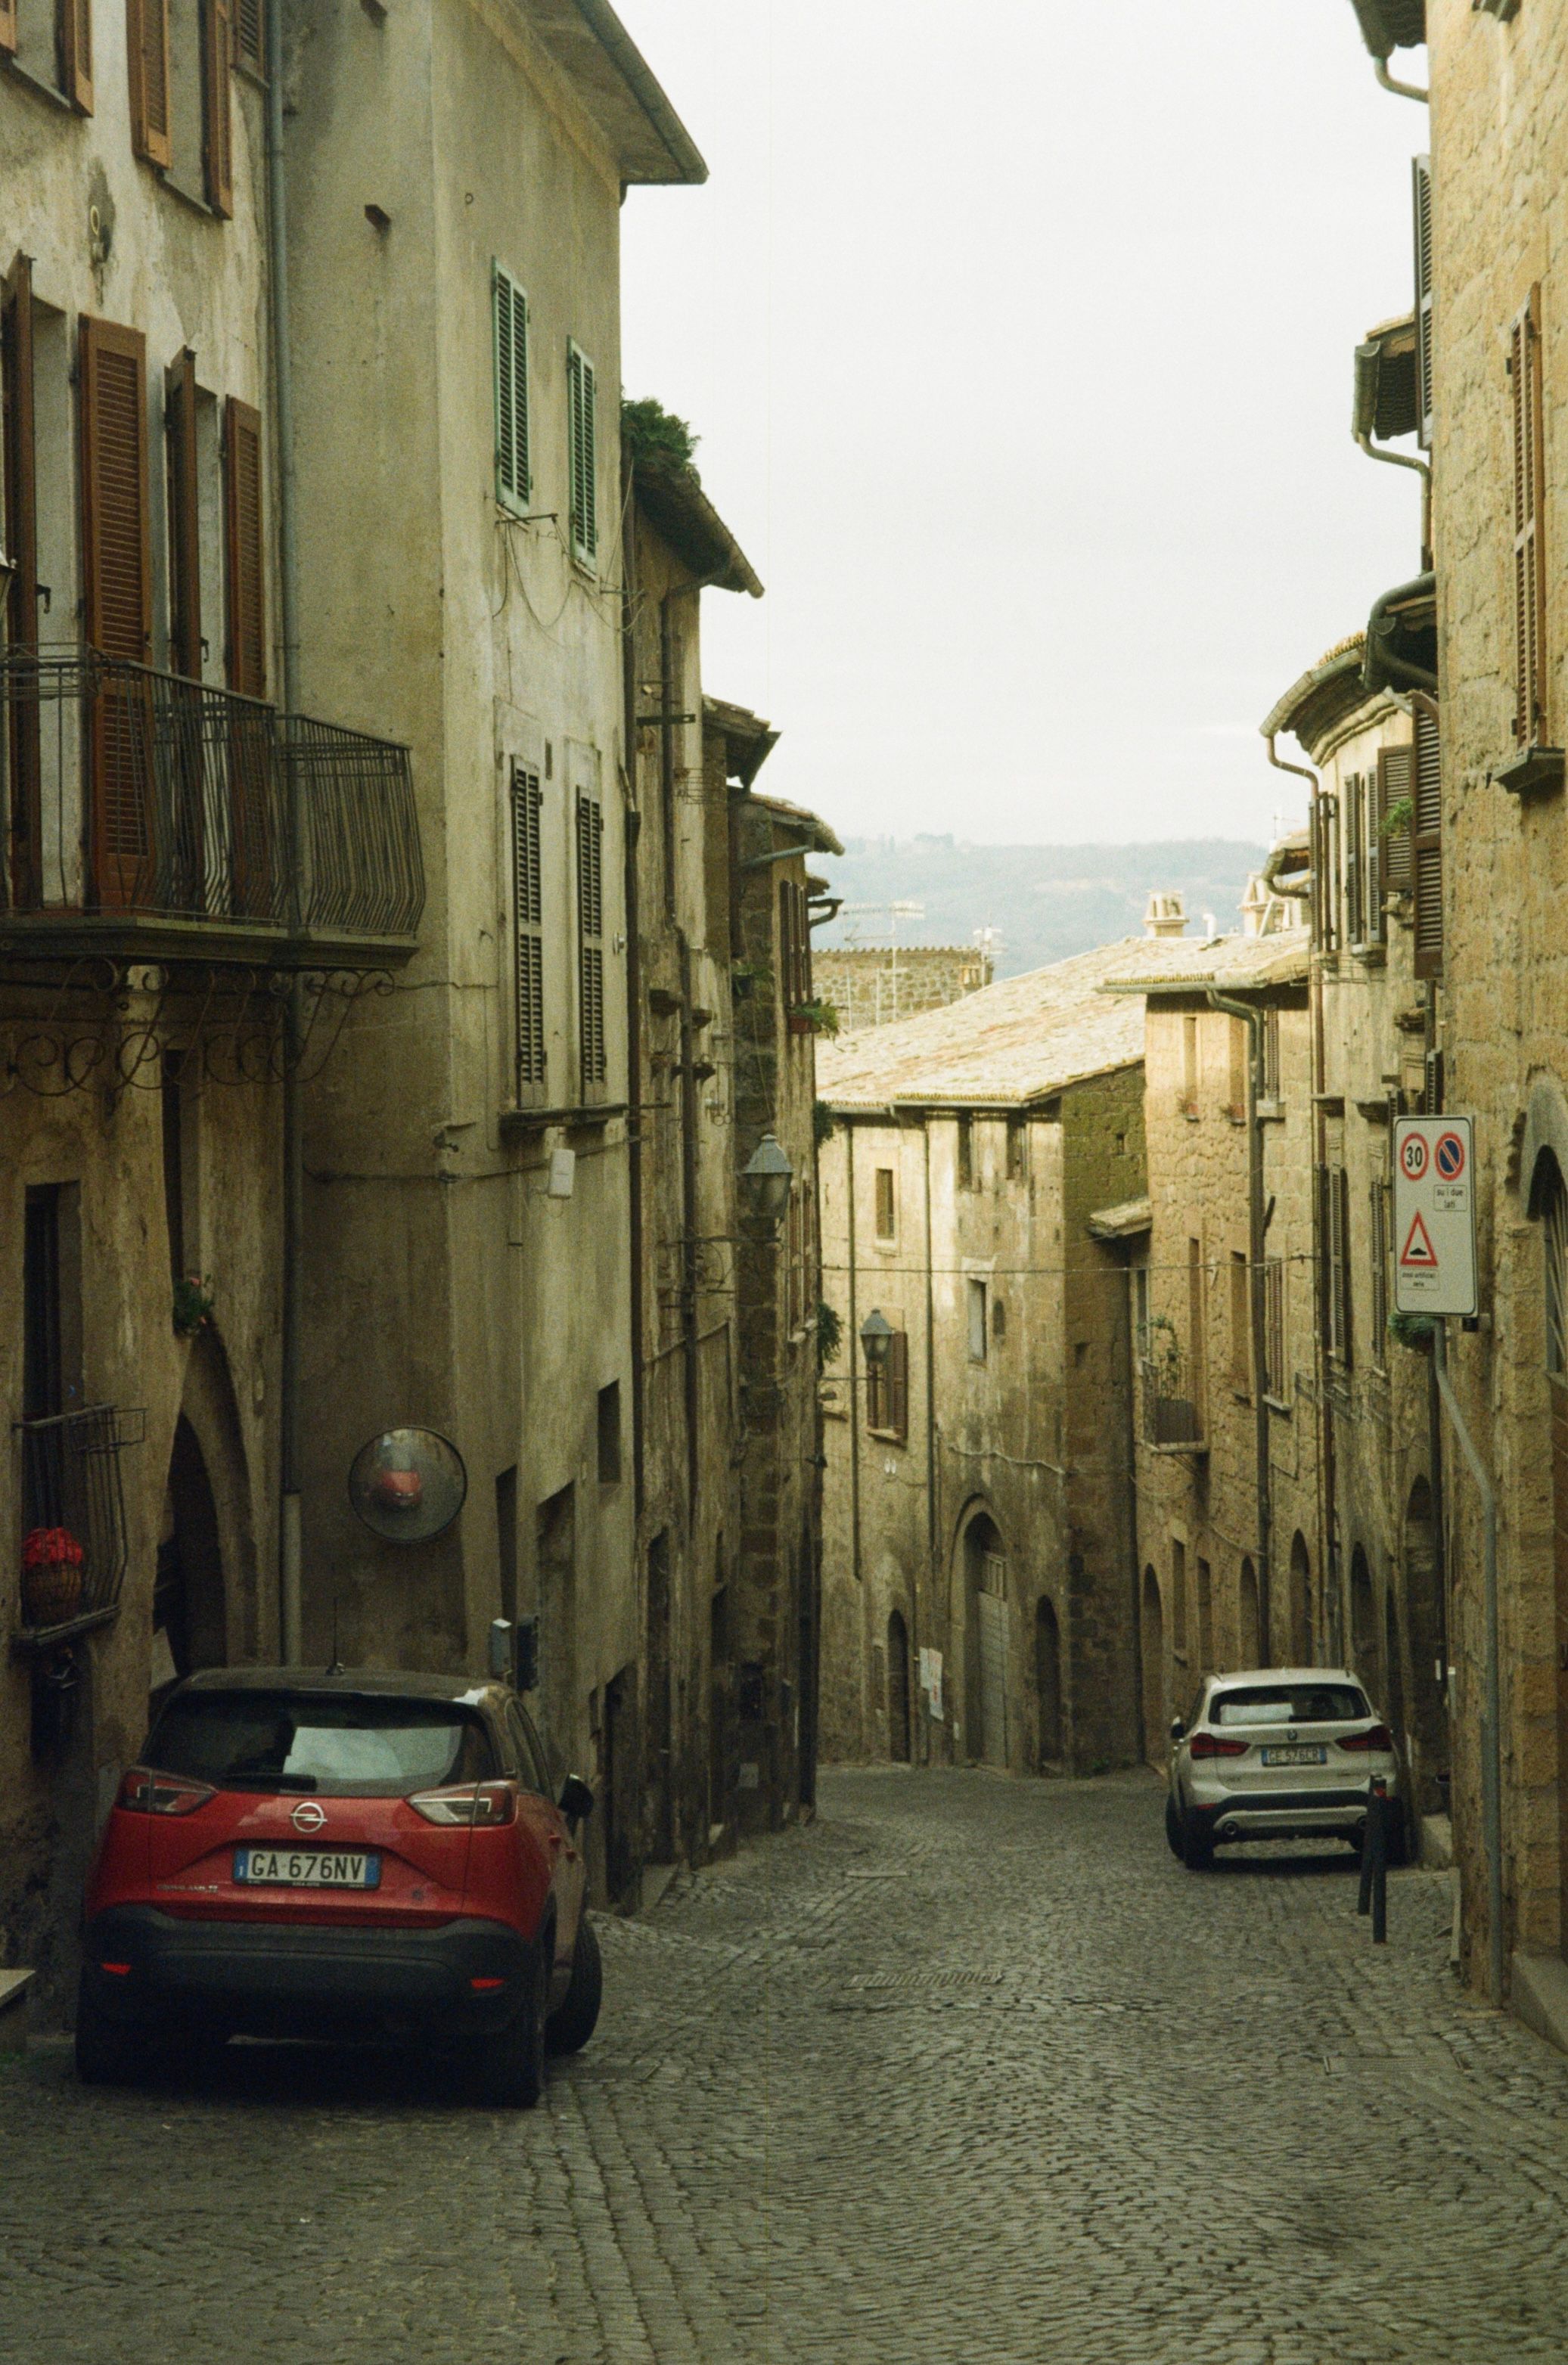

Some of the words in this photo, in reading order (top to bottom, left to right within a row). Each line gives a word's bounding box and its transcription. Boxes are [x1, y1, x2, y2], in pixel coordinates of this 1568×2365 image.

[1406, 1146, 1423, 1167] 30
[1451, 1187, 1464, 1196] due
[252, 1854, 278, 1877] GA
[289, 1855, 362, 1879] 676NV
